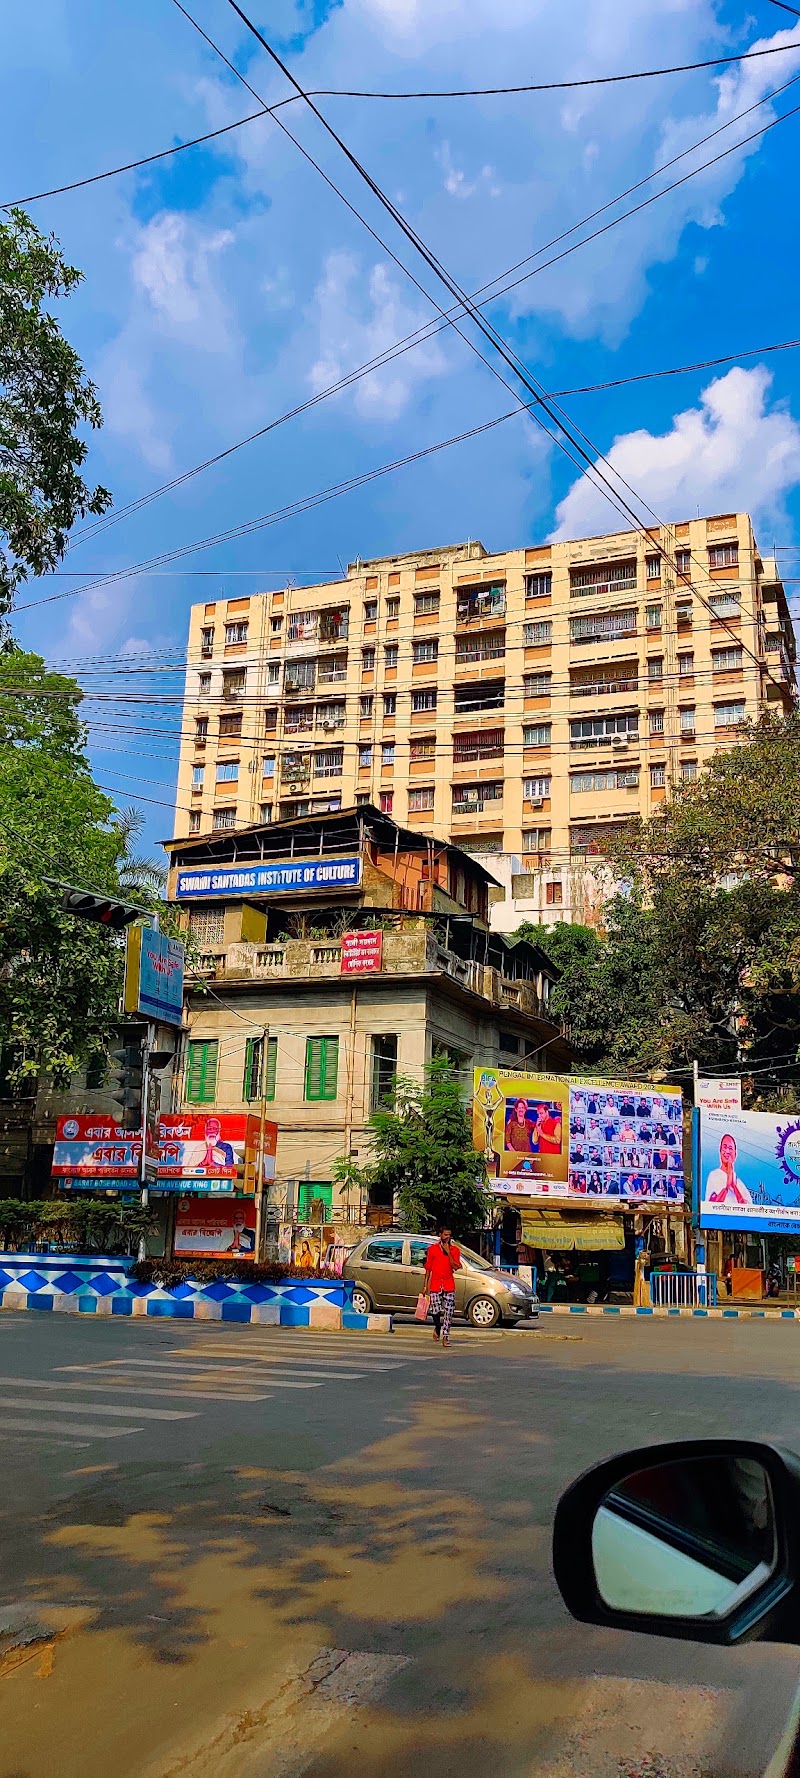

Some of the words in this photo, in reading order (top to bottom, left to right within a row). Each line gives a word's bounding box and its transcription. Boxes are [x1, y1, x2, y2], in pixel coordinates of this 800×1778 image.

[180, 874, 210, 892] SWAMI
[212, 874, 255, 890] SANTADAS
[258, 870, 302, 886] INSTITUTE
[304, 869, 315, 882] OF
[316, 864, 356, 882] CULTURE
[147, 951, 156, 960] You
[168, 960, 179, 970] Safe
[153, 962, 166, 974] With
[166, 968, 173, 976] Us
[526, 1074, 578, 1084] INTERNATIONAL
[580, 1079, 619, 1088] EXCELLENCE
[84, 1126, 112, 1139] এবার
[155, 1121, 192, 1139] রিবর্তন
[92, 1146, 128, 1162] এবার
[130, 1142, 180, 1162] বিপি
[166, 1180, 191, 1188] AVENUE
[192, 1180, 208, 1188] XING
